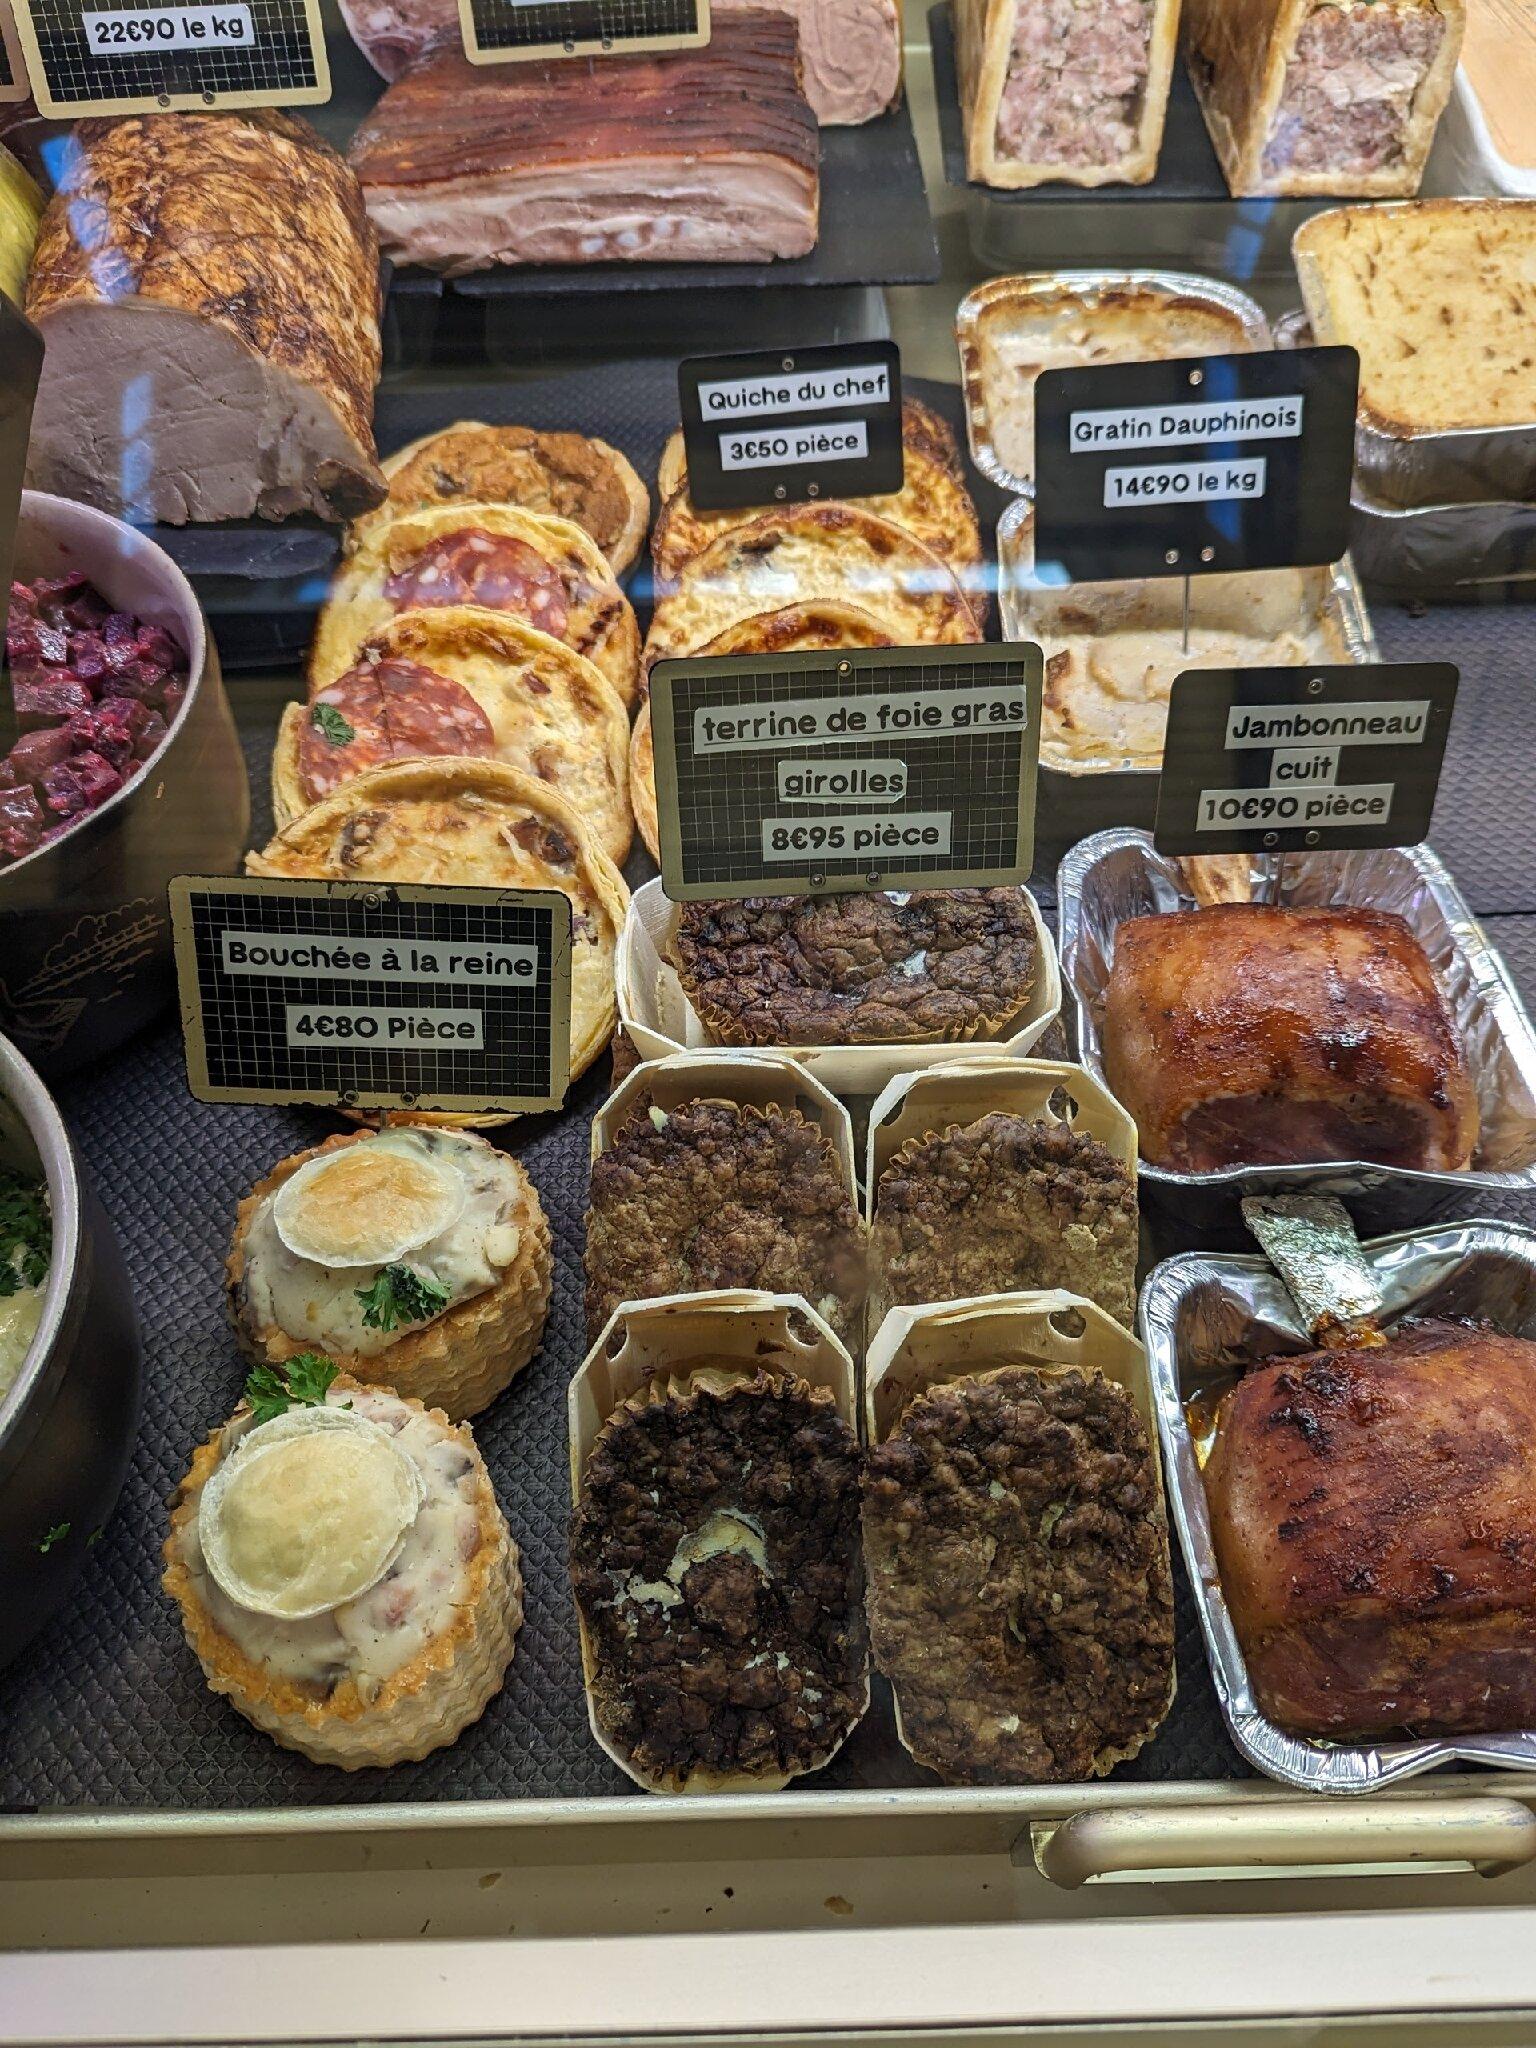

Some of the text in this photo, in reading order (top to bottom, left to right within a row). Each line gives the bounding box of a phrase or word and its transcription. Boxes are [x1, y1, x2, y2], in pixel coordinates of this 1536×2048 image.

[95, 15, 244, 44] 22€90 le kg
[708, 374, 886, 411] Quiche du chef
[1074, 405, 1297, 443] Gratin Dauphinois
[730, 434, 858, 461] 3€50 pièce
[1114, 469, 1256, 498] 14€90 le kg
[702, 699, 1024, 742] terrine de foie gras
[1232, 713, 1422, 739] Jambonneau
[784, 768, 904, 797] girolles
[1275, 756, 1333, 780] cuit
[1205, 794, 1385, 821] 10€90 pièce
[771, 823, 940, 851] 8€95 pièce
[228, 941, 534, 976] Bouchée à la reine
[294, 1014, 476, 1041] 4€80 Pièce
